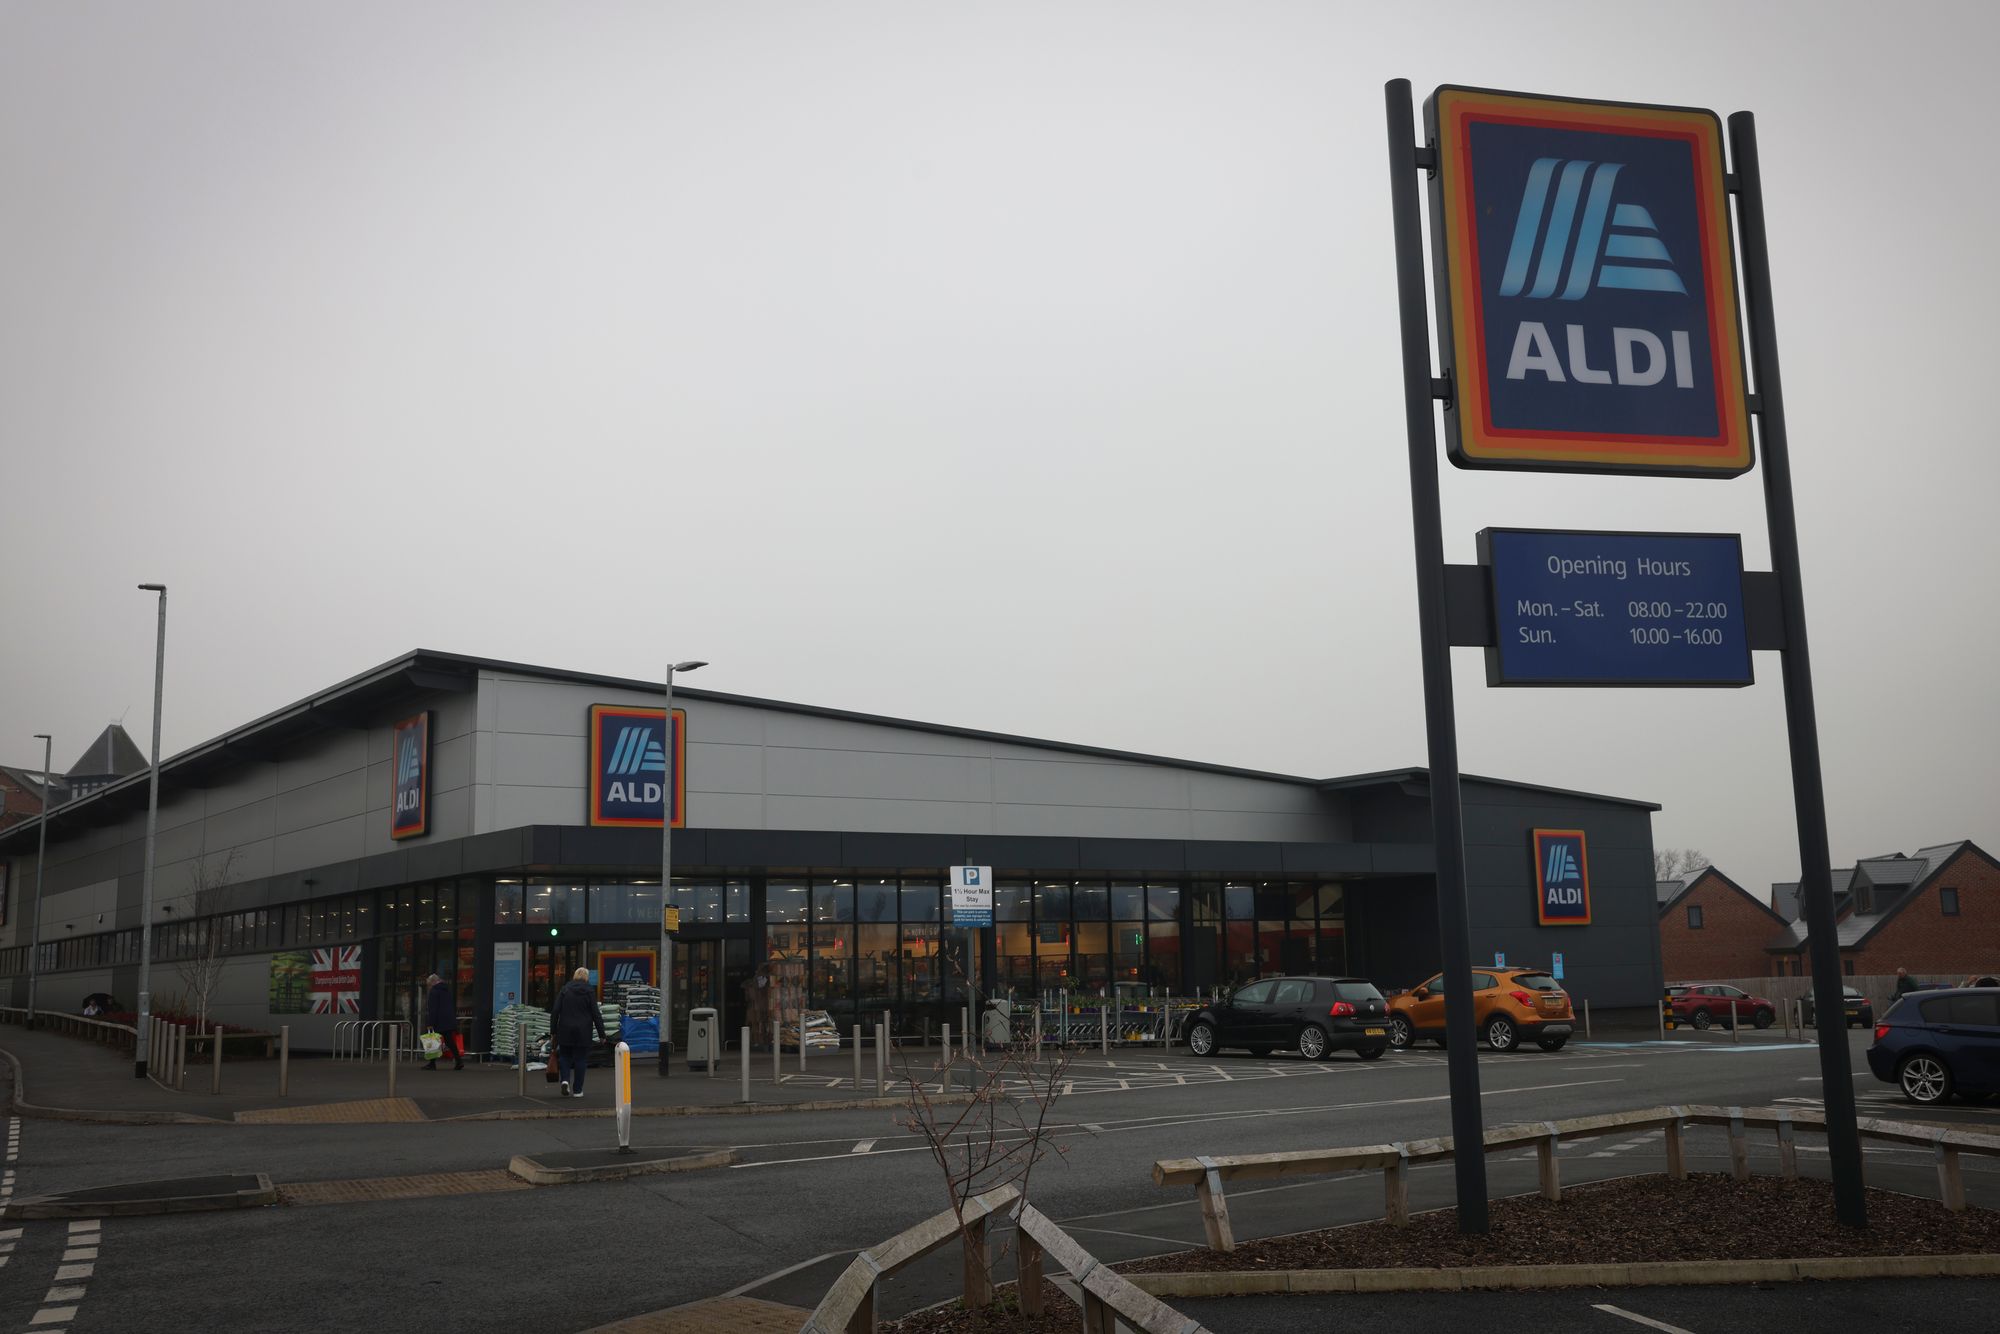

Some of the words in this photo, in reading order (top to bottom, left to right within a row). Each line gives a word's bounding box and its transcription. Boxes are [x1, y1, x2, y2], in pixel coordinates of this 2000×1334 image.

[1506, 321, 1694, 389] ALDI
[1547, 555, 1627, 580] Opening
[1637, 557, 1692, 576] Hours
[1519, 626, 1557, 643] Sun.
[397, 788, 419, 813] ALDI
[966, 869, 978, 884] P
[1547, 888, 1582, 904] ALDI
